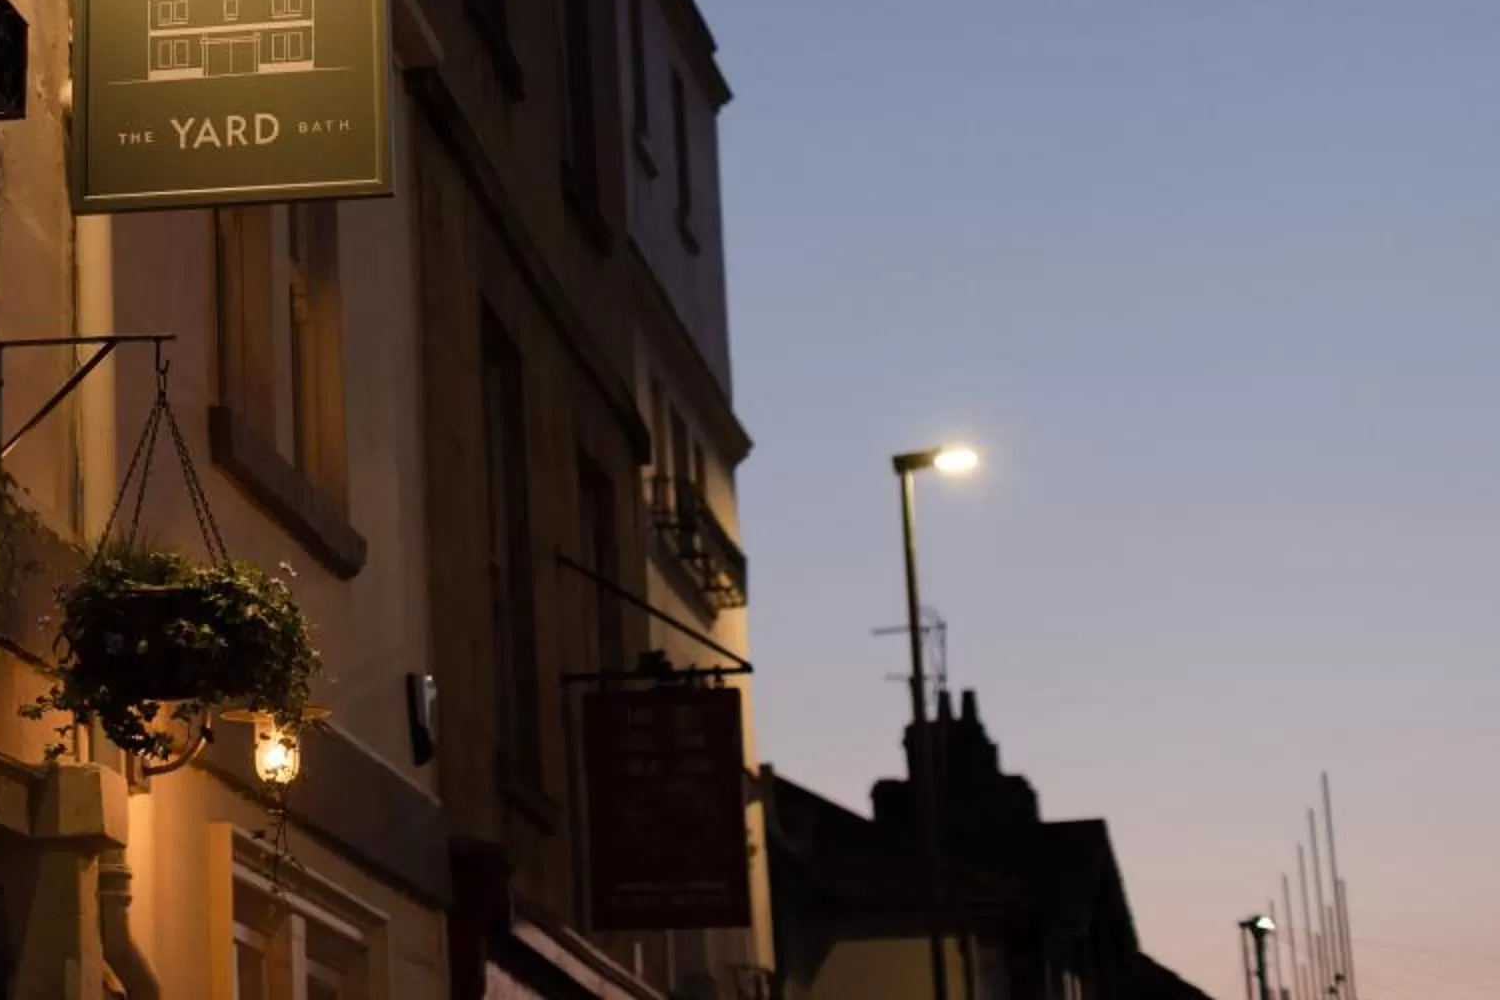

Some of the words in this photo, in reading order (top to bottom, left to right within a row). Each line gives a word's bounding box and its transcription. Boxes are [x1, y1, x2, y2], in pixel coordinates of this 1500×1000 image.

[117, 131, 155, 146] THE
[169, 112, 280, 150] YARD
[297, 119, 351, 135] BATH
